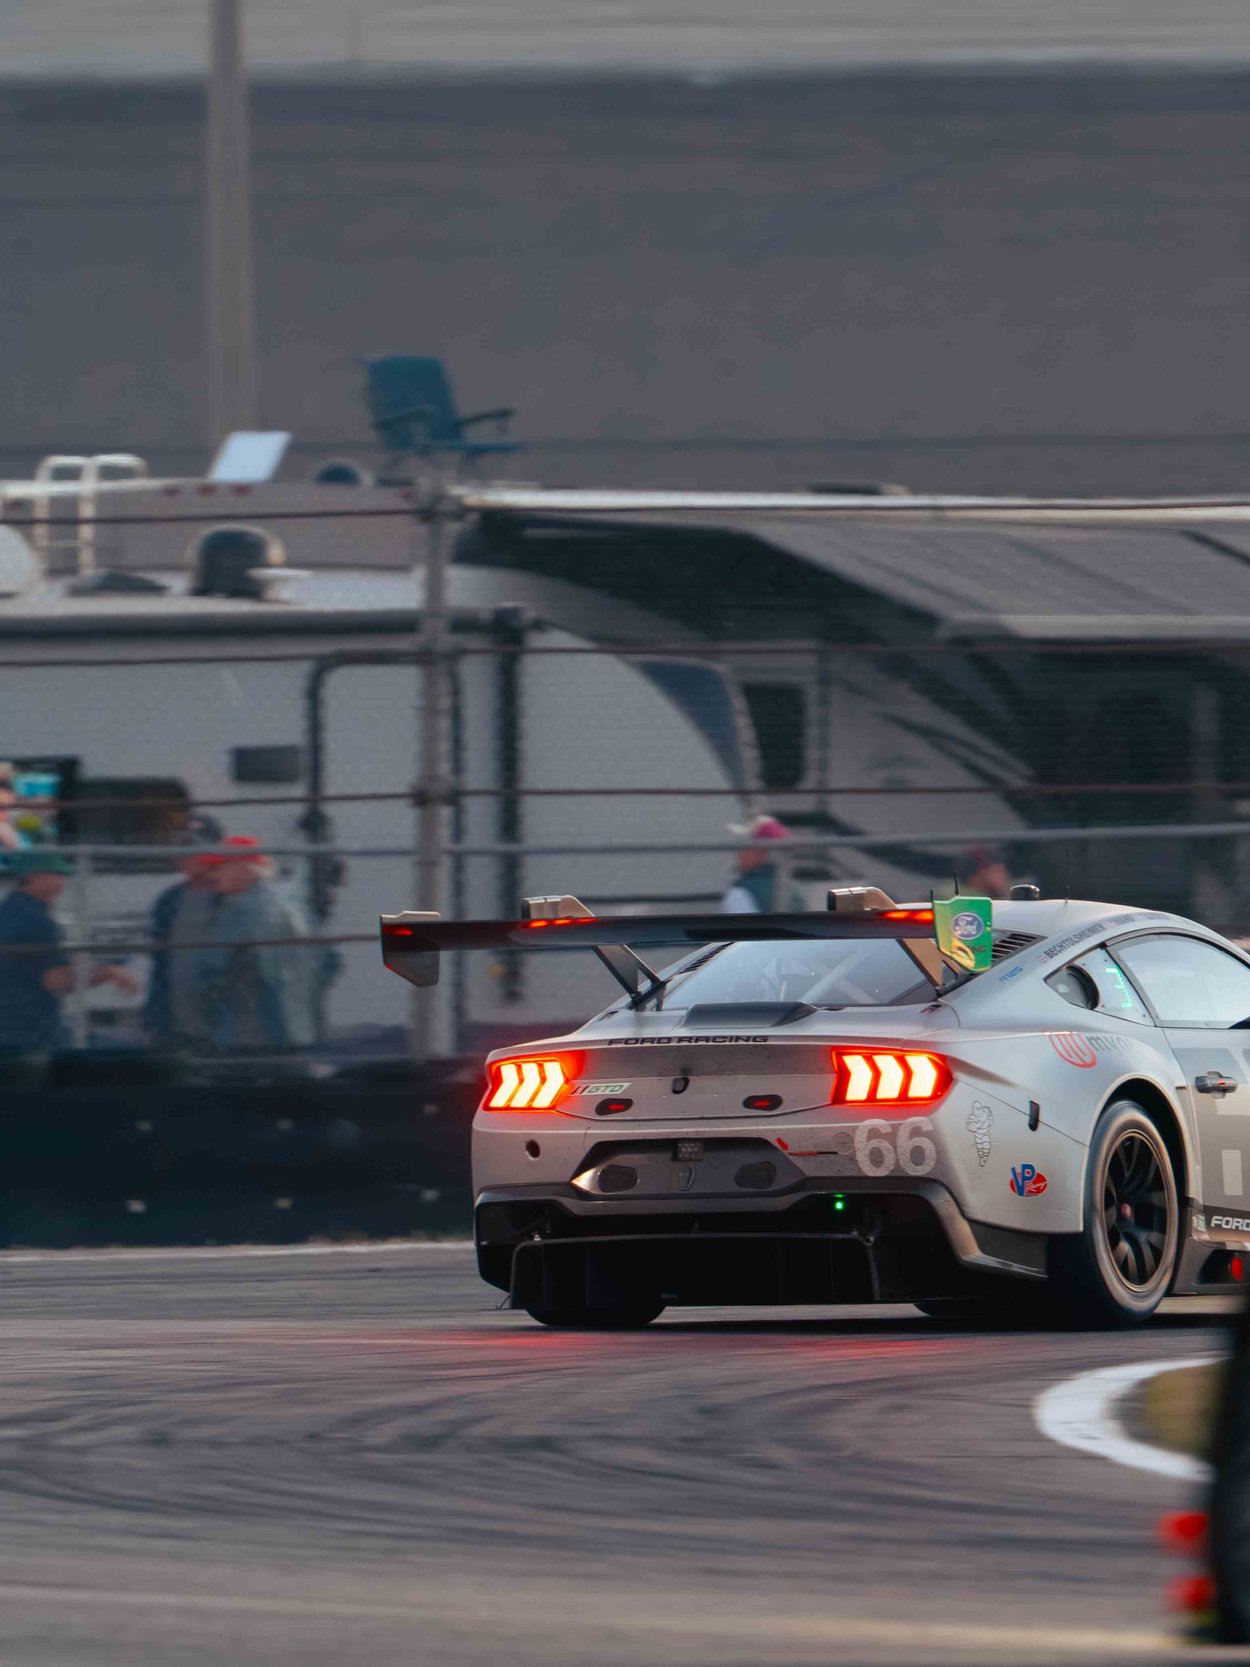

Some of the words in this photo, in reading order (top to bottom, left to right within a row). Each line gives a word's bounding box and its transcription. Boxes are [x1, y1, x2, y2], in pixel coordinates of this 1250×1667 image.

[608, 1036, 671, 1046] FORD
[675, 1035, 769, 1044] RACING
[587, 1084, 625, 1093] GTD
[854, 1116, 937, 1176] 66
[1010, 1163, 1036, 1197] VP
